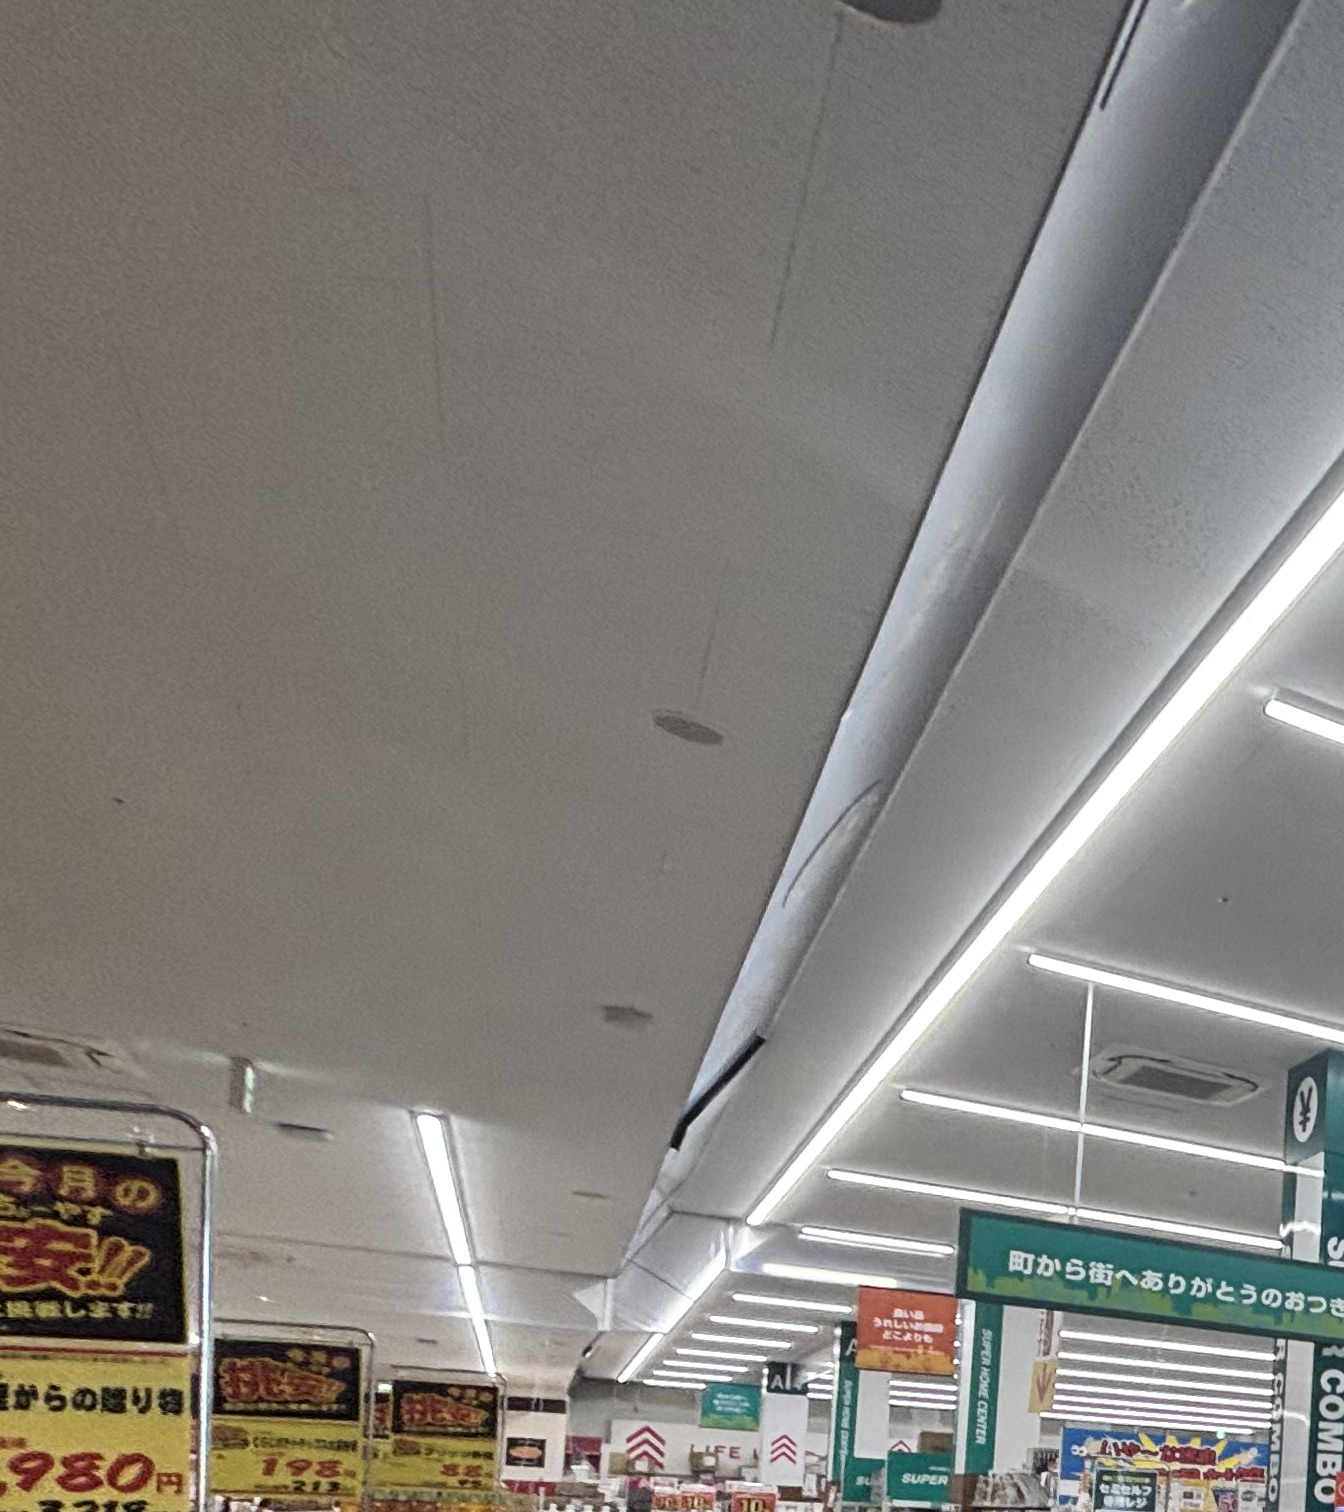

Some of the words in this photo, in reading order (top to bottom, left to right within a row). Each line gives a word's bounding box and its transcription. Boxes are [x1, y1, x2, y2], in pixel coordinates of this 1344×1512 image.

[979, 1328, 994, 1365] SUPER
[977, 1367, 991, 1398] HOME
[974, 1400, 989, 1445] CENTER
[901, 1471, 949, 1486] SUPER
